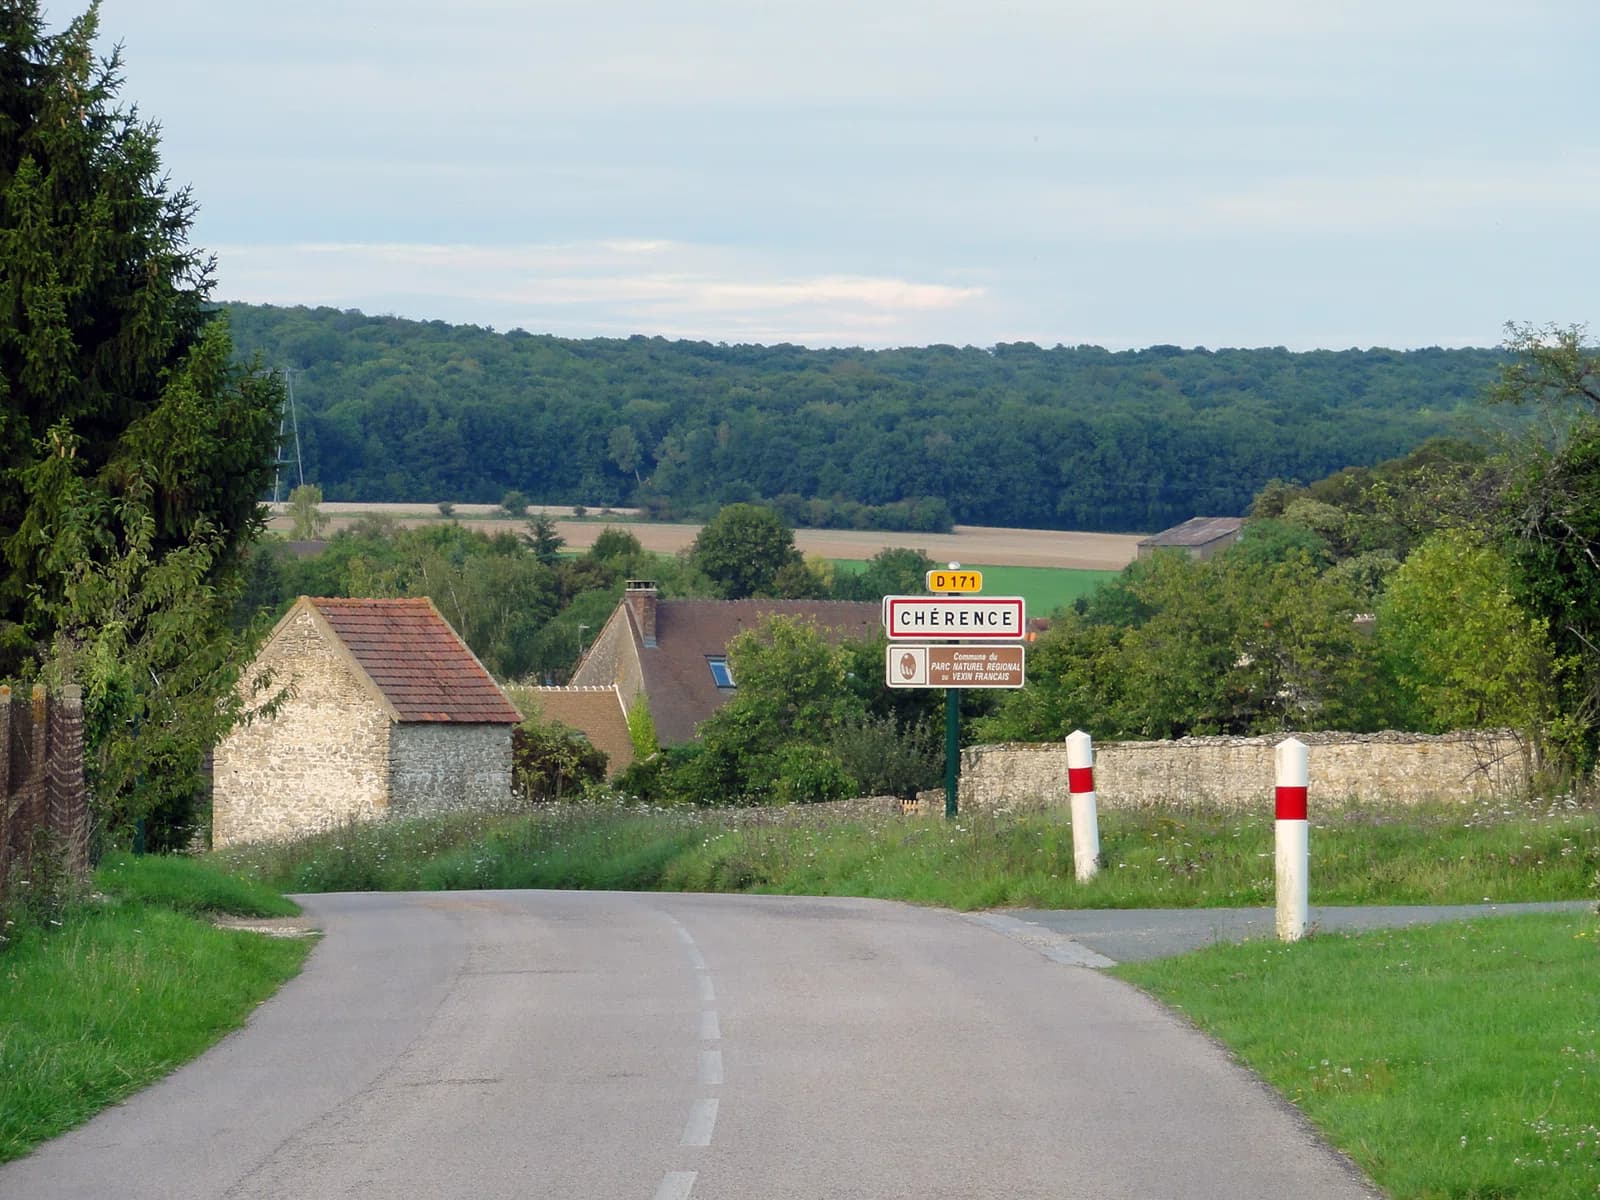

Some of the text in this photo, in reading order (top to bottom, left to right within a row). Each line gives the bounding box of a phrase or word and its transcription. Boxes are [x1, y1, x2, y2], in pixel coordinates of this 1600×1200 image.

[936, 576, 976, 588] D 171
[901, 608, 1012, 626] CHÉRENCE
[954, 652, 998, 660] Commune du
[931, 662, 950, 670] PARC
[952, 662, 984, 670] NATUREL
[952, 672, 973, 680] VEXIN
